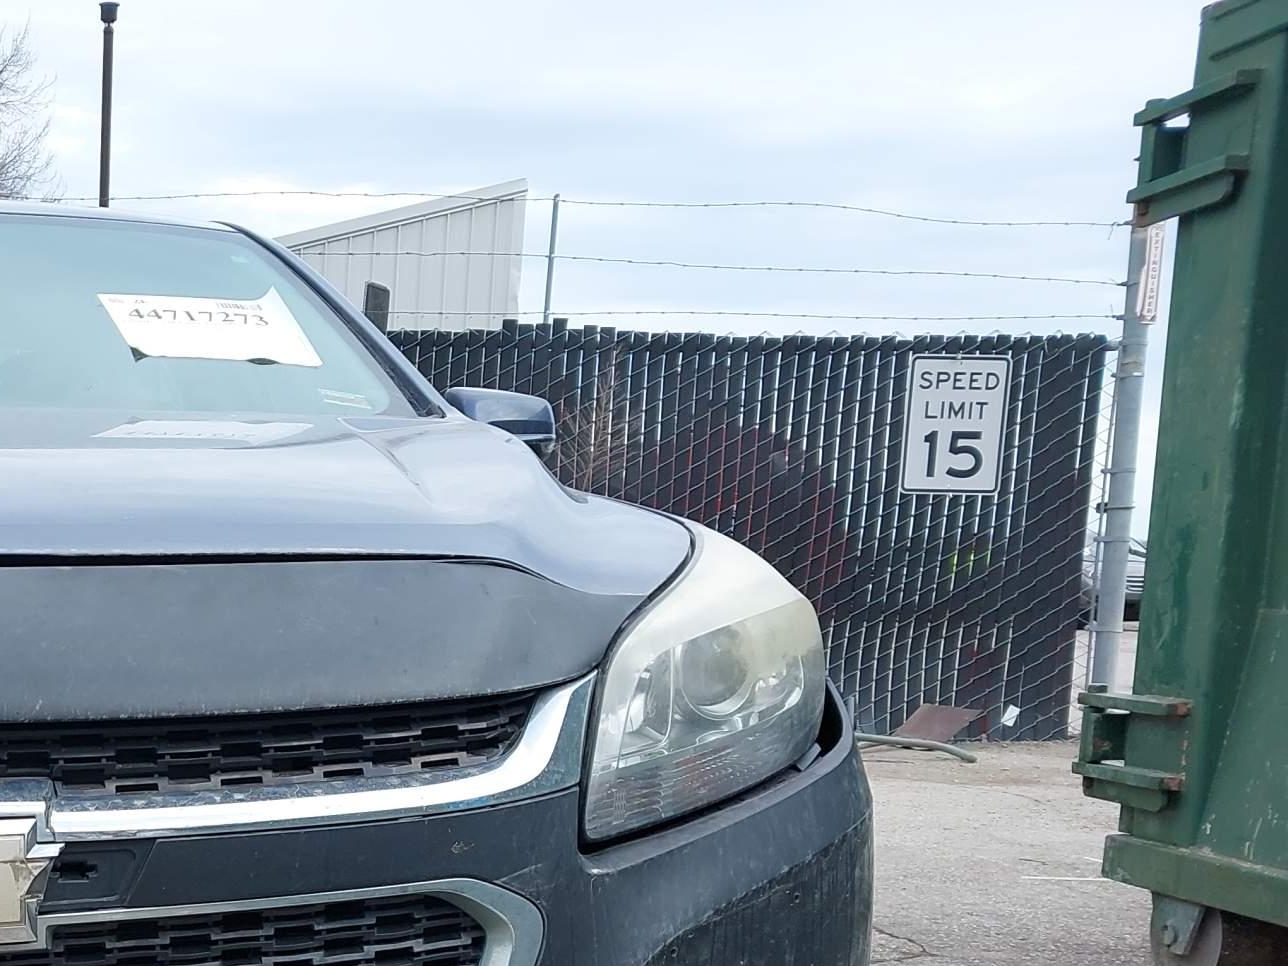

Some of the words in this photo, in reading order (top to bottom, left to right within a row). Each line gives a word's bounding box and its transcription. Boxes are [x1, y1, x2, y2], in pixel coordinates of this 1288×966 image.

[1146, 231, 1161, 314] EXTINGUISHER
[128, 308, 269, 326] 44717273
[919, 371, 1000, 390] SPEED
[924, 401, 989, 419] LIMIT
[923, 430, 984, 478] 15
